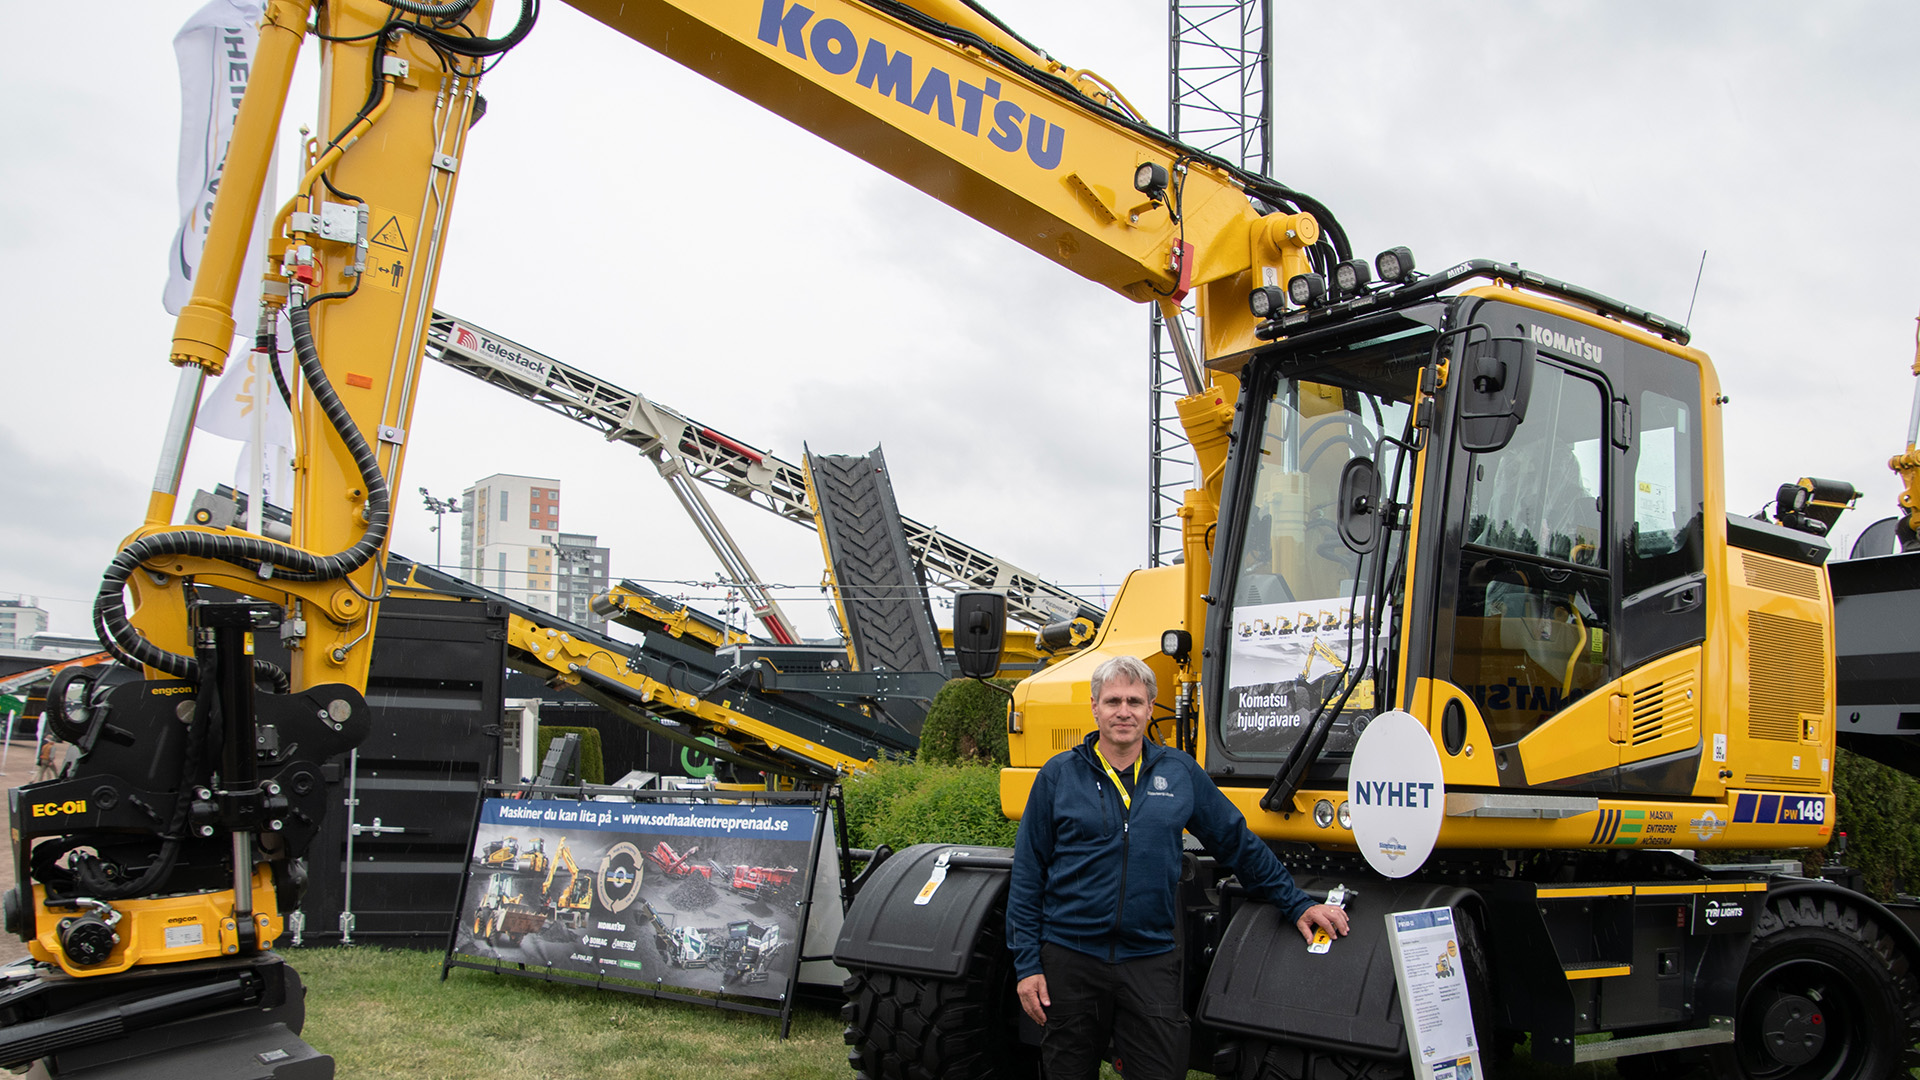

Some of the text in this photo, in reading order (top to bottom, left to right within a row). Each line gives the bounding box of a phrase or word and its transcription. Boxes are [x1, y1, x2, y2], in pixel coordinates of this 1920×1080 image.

[757, 0, 1065, 170] KOMATSU
[1531, 323, 1602, 364] KOMATSU
[481, 337, 546, 375] Telestack
[151, 685, 191, 696] engcon
[1238, 692, 1288, 708] Komatsu
[1237, 712, 1300, 731] hjulgrävare
[1356, 781, 1434, 808] NYHET
[32, 800, 87, 818] EC-Oil
[1649, 811, 1673, 820] MASKIN
[499, 805, 542, 820] Maskiner
[543, 809, 556, 821] du
[558, 809, 578, 822] kan
[579, 811, 597, 823] lita
[597, 810, 611, 826] på
[622, 813, 788, 832] www.sodhaakentreprenad.se
[1646, 824, 1677, 834] ENTREPRE
[168, 915, 197, 925] engcon
[1705, 907, 1744, 918] TYRI LIGHTS
[597, 921, 626, 932] KOMATSU
[590, 937, 608, 946] BOMAG
